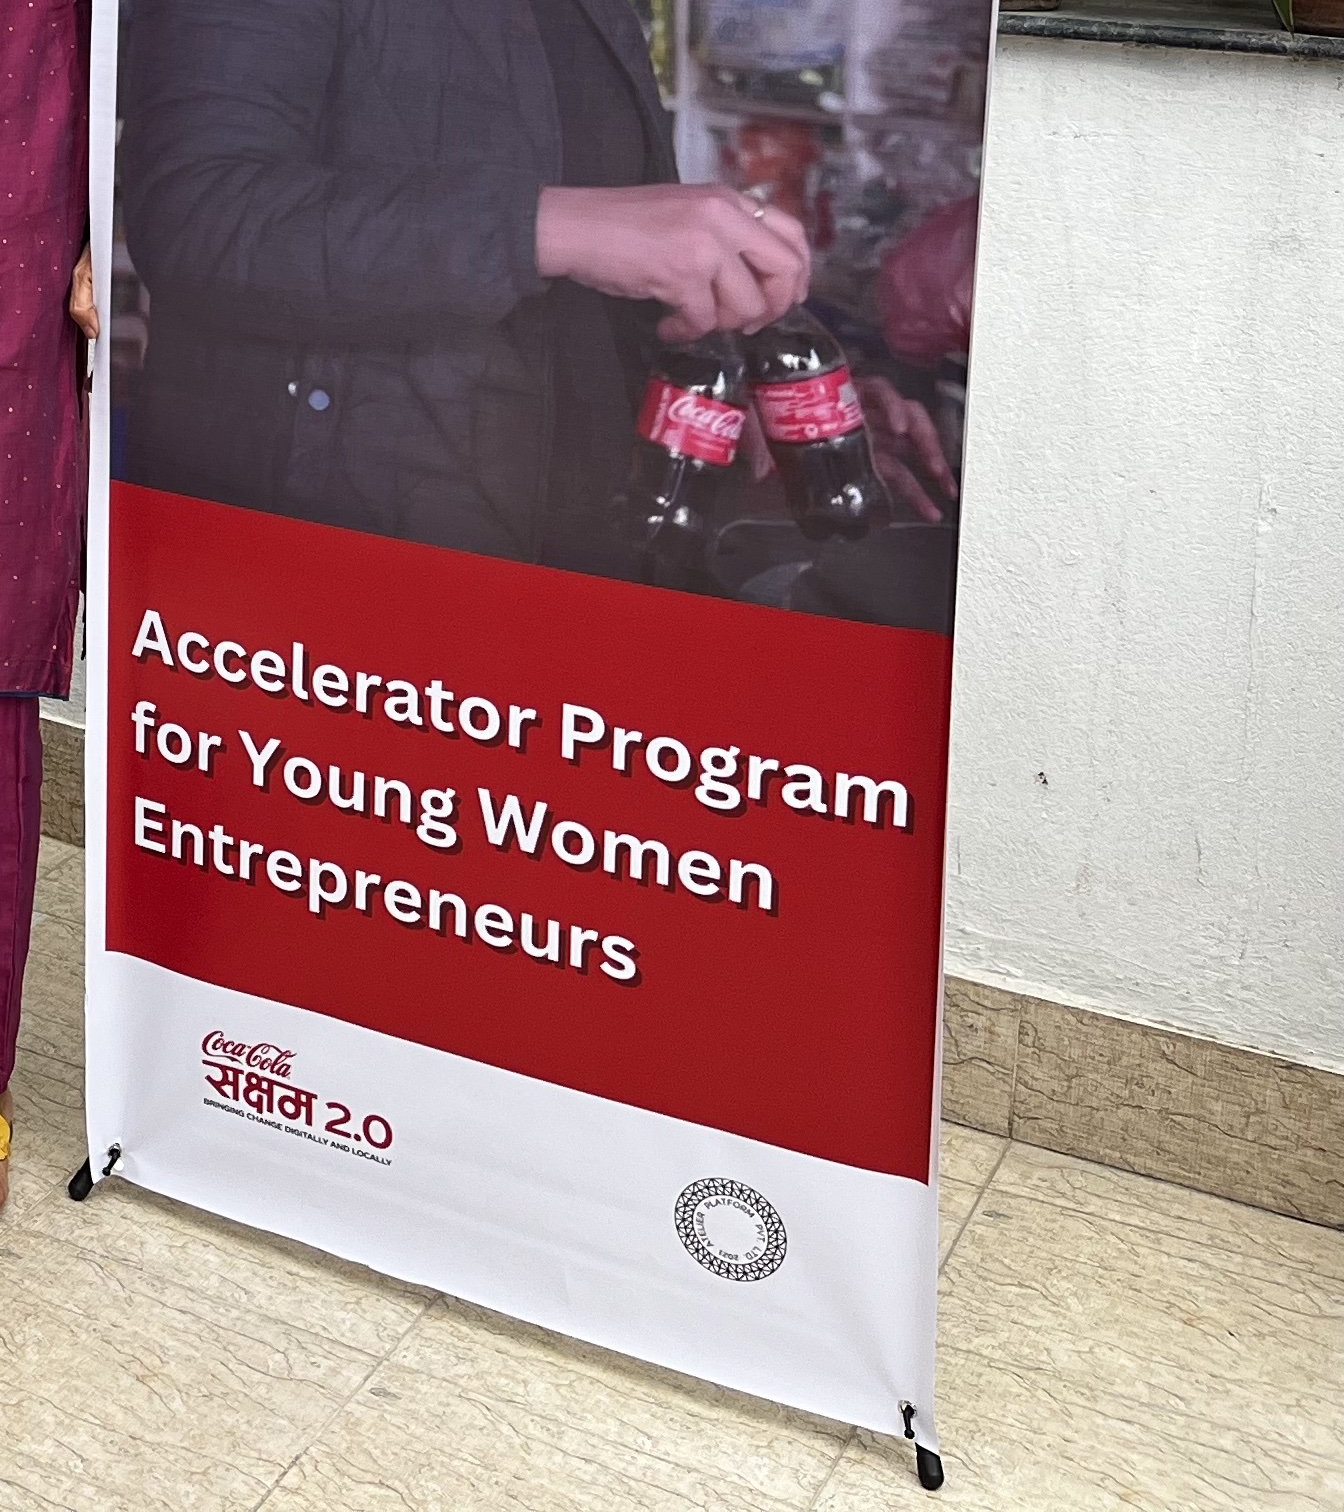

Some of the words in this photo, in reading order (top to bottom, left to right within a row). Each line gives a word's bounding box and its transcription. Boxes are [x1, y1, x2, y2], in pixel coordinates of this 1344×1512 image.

[131, 608, 539, 750] Accelerator
[560, 701, 910, 829] Program
[130, 699, 224, 774] for
[237, 728, 459, 849] Young
[476, 787, 775, 912] Women
[133, 795, 638, 981] Entrepreneurs
[201, 1030, 297, 1079] Coca-Cola
[201, 1059, 318, 1127] सक्षम
[324, 1101, 394, 1150] 2.0
[203, 1097, 245, 1118] BRINGING
[246, 1112, 283, 1131] CHANGE
[284, 1125, 328, 1145] DIGITALLY
[329, 1140, 351, 1153] AND
[351, 1147, 392, 1167] LOCALLY
[703, 1197, 755, 1218] PLATFORM
